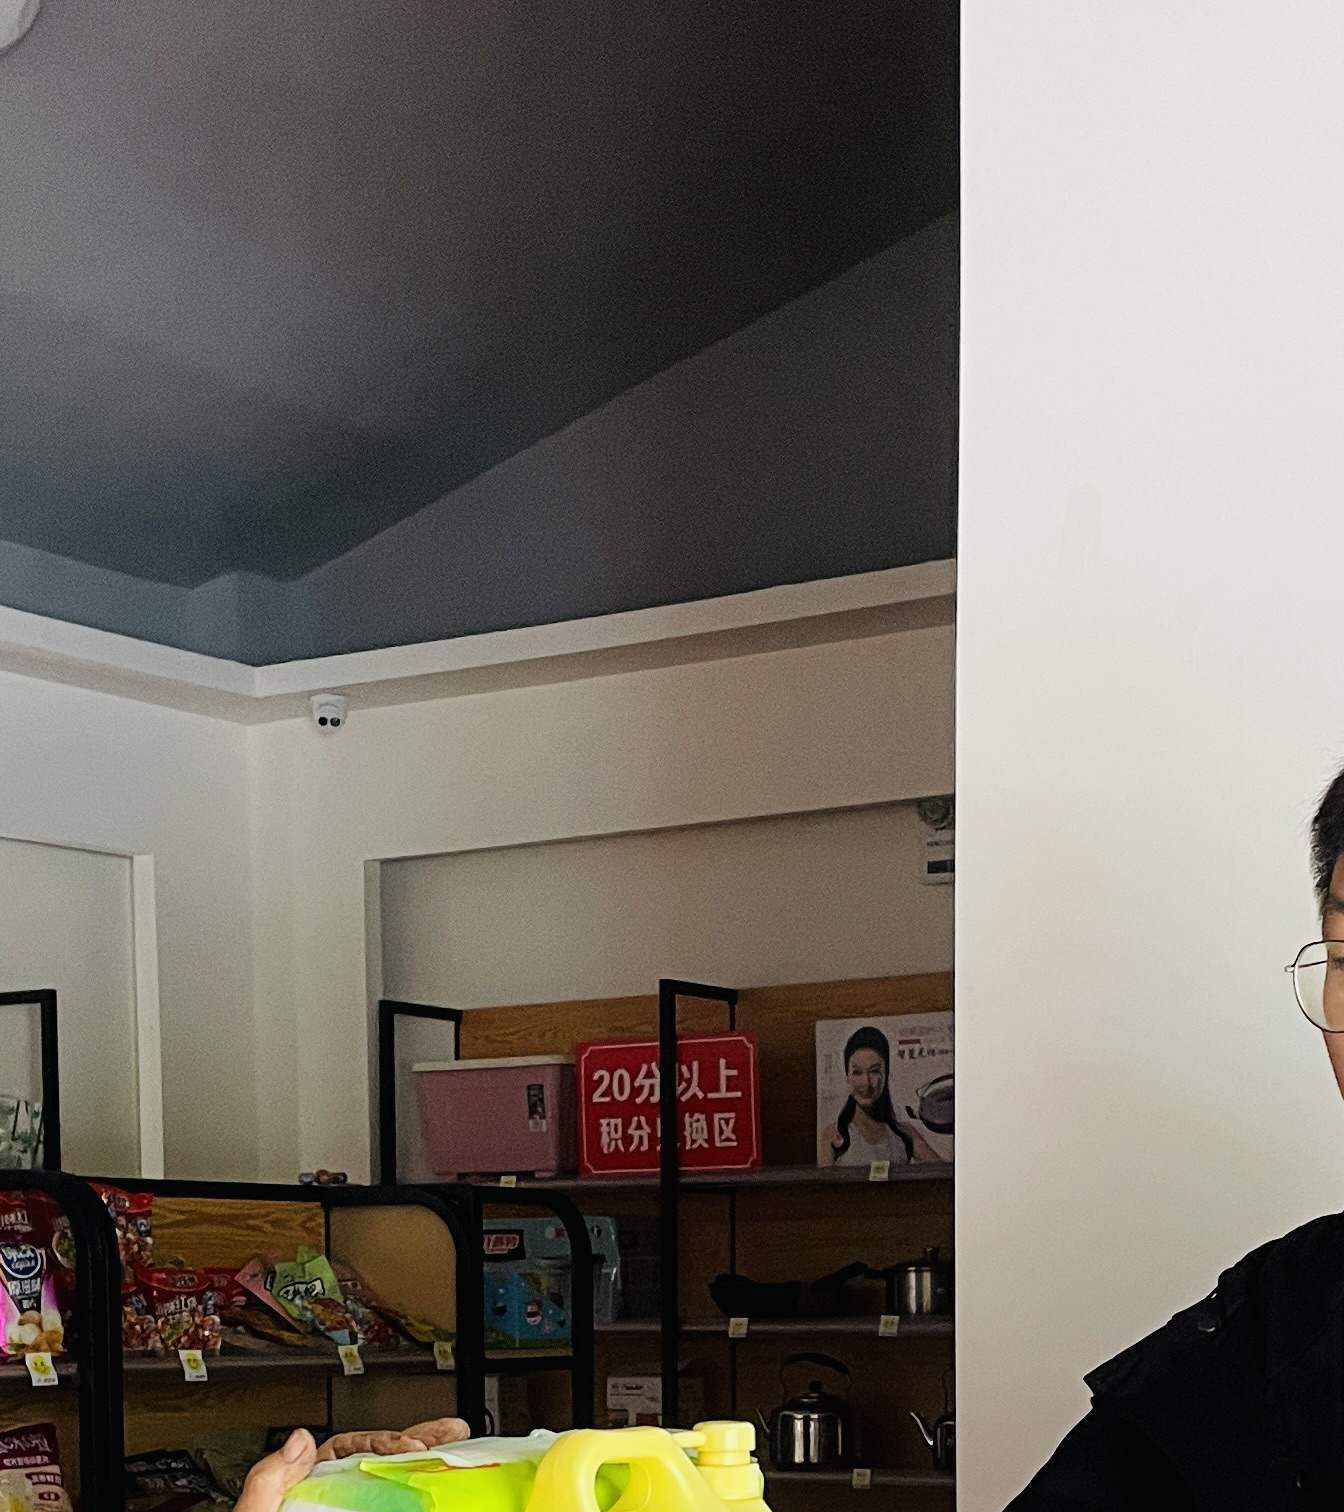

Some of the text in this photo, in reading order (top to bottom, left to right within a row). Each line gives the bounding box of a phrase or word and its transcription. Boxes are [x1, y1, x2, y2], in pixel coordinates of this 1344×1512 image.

[592, 1058, 742, 1104] 20分以上
[600, 1112, 738, 1153] 积分换区
